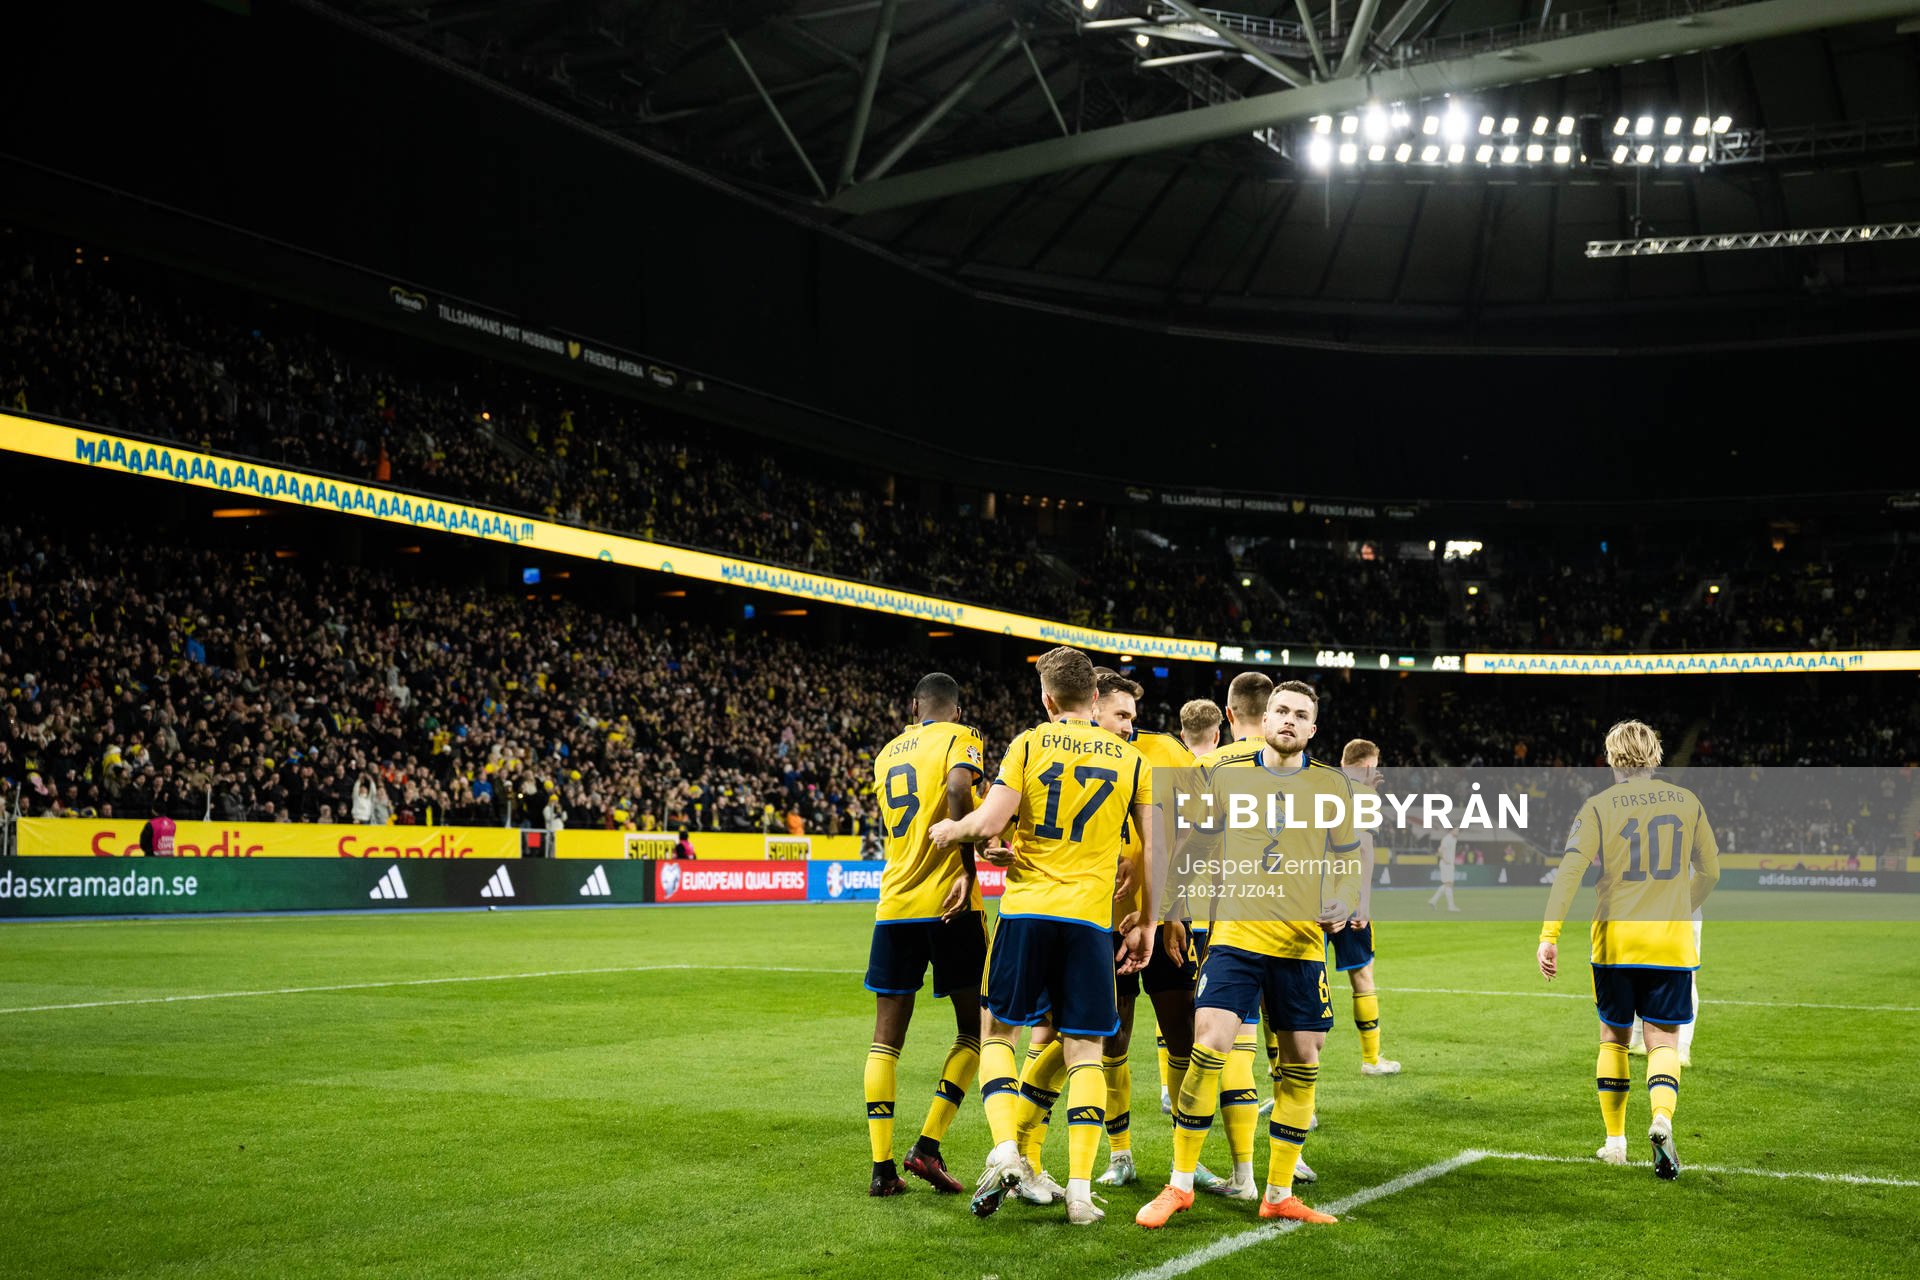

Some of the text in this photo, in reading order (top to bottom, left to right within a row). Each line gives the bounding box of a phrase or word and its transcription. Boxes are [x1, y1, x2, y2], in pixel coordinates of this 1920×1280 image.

[438, 303, 500, 336] TILLSAMMANS
[501, 324, 520, 342] MOT
[583, 348, 616, 372] FRIENDS
[618, 357, 644, 380] ARENA
[1432, 656, 1461, 671] AZE
[889, 737, 919, 758] ISAK
[1041, 734, 1123, 759] GYÖKERES
[885, 762, 920, 839] 9
[1034, 762, 1118, 842] 17
[1612, 790, 1685, 808] FORSBERG
[1620, 814, 1683, 881] 10
[682, 872, 805, 890] EUROPEAN QUALIFIERS
[1758, 873, 1878, 888] adidasxramadan.se
[1318, 970, 1329, 1003] 6
